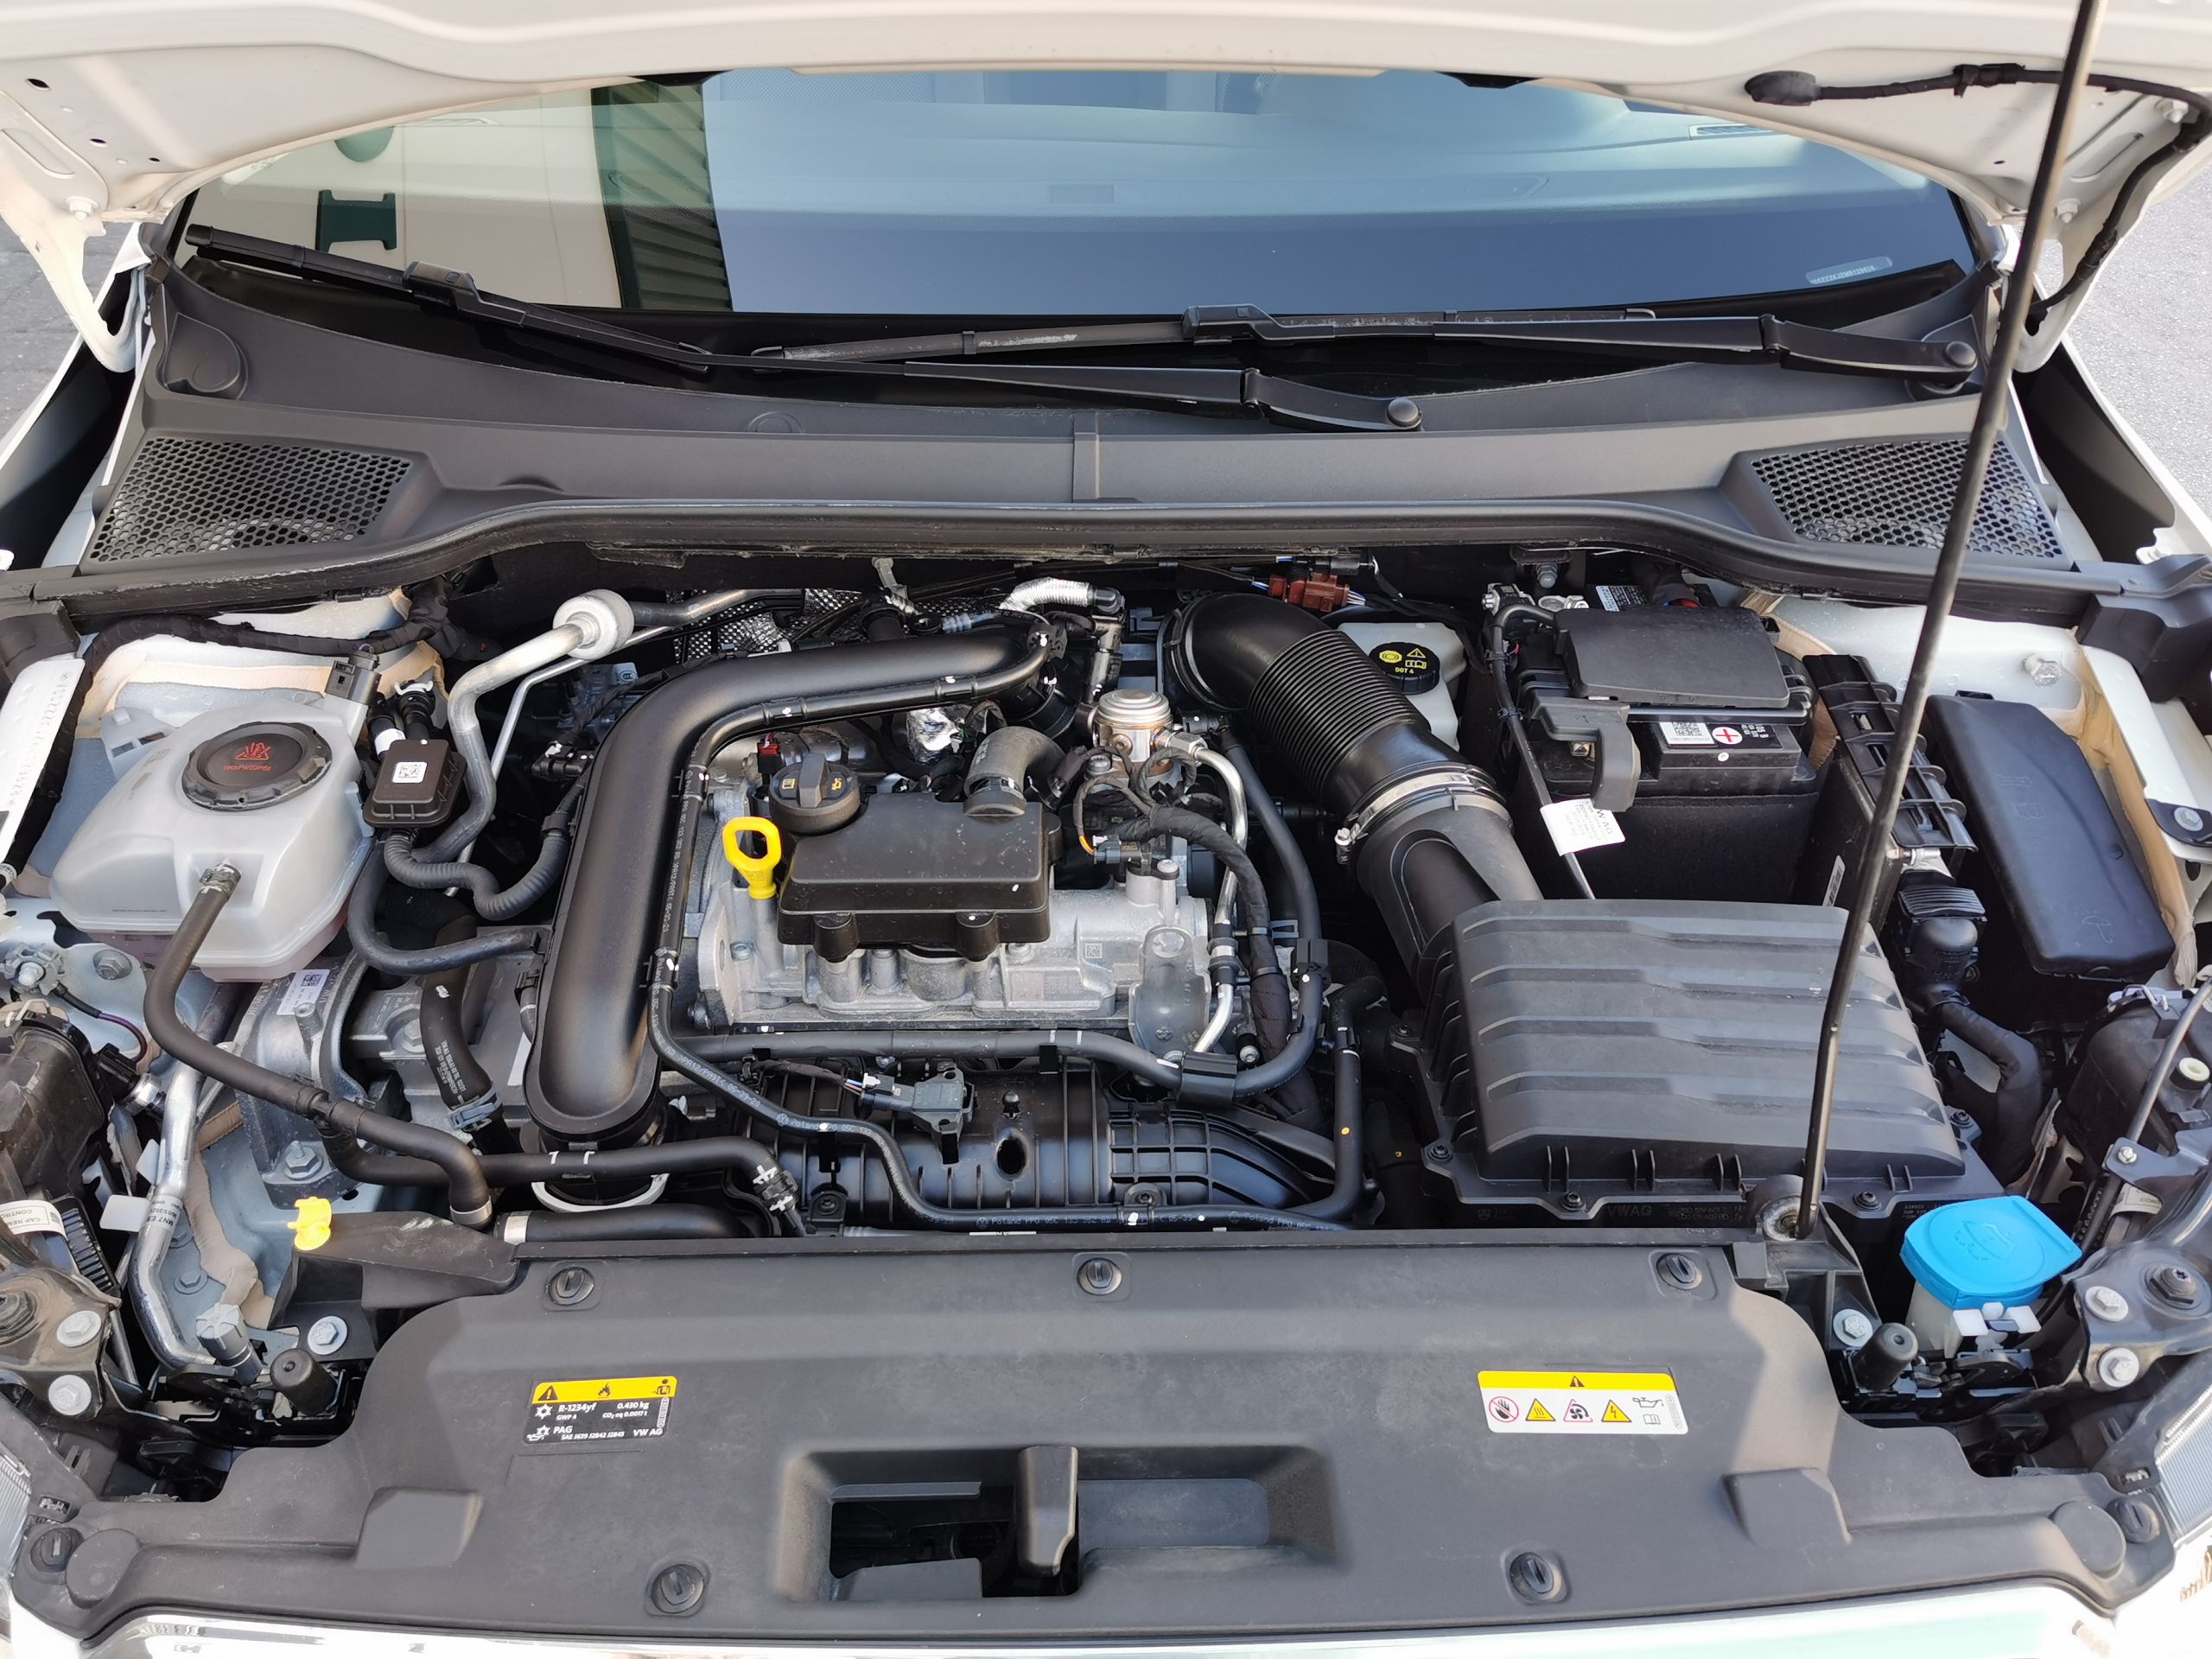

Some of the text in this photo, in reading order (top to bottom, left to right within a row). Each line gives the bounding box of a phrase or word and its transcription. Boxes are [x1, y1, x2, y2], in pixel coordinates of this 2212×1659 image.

[991, 1217, 1021, 1225] Poland
[558, 1402, 598, 1413] R-1234yf
[639, 1402, 650, 1410] kg
[553, 1426, 573, 1434] PAG
